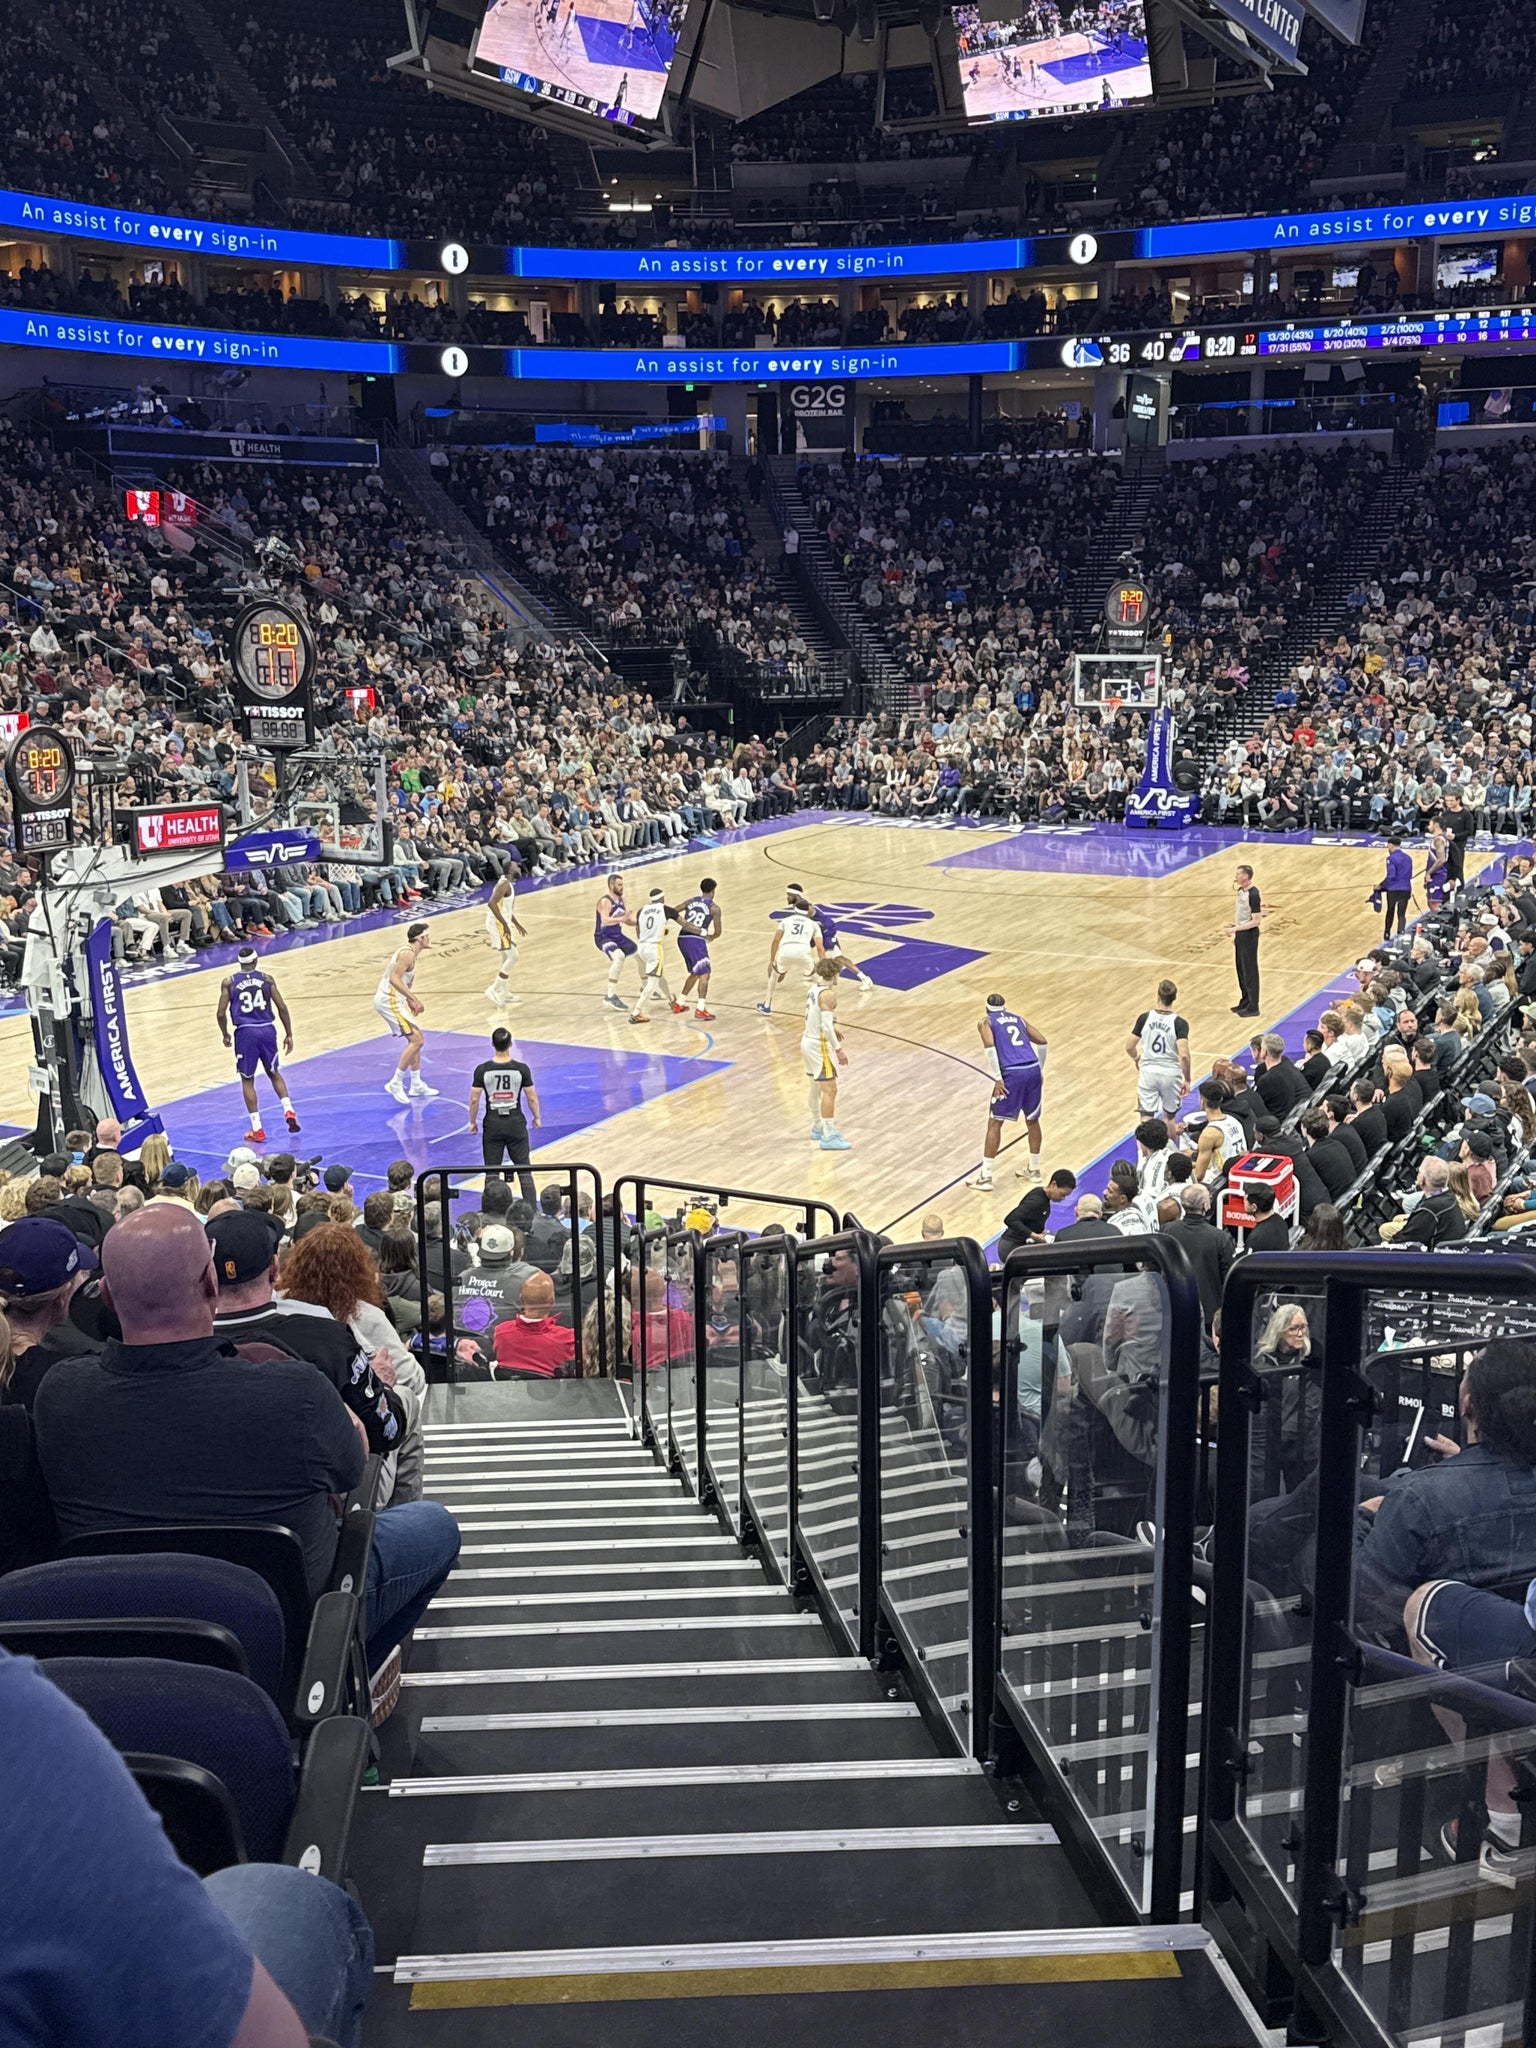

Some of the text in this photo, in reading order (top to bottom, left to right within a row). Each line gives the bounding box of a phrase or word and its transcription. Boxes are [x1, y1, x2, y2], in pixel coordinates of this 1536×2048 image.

[1257, 0, 1299, 47] CENTER
[504, 67, 521, 84] GSW
[541, 81, 551, 96] 36
[588, 97, 598, 111] 40
[617, 107, 629, 124] UTA
[22, 202, 277, 251] An assist for every sign-in
[1274, 203, 1536, 238] An assist for every sig
[638, 254, 903, 274] An assist for every sign-in
[1439, 322, 1445, 331] 5
[1460, 321, 1466, 329] 7
[1479, 320, 1488, 328] 12
[1501, 319, 1509, 327] 11
[1523, 317, 1529, 327] 2
[1323, 327, 1368, 338] 8/20 (40%)
[1381, 323, 1424, 335] 2/2 (100%)
[1499, 330, 1509, 339] 14
[1522, 329, 1529, 338] 4
[26, 320, 278, 358] An assist for every sign-in
[1245, 334, 1255, 344] 17
[1267, 330, 1313, 342] 13/30 (43%)
[1382, 335, 1421, 346] 3/4 (75%)
[1438, 334, 1444, 343] 6
[1457, 333, 1467, 341] 10
[1478, 332, 1488, 340] 16
[1206, 336, 1236, 357] 8:20
[1241, 345, 1256, 355] 2ND
[1268, 342, 1312, 353] 17/31 (55%)
[1324, 338, 1366, 350] 3/10 (30%)
[1109, 343, 1130, 363] 36
[1142, 341, 1165, 361] 40
[636, 355, 898, 374] An assist for every sign-in
[790, 384, 846, 408] G2G
[247, 443, 281, 454] HEALTH
[1121, 590, 1143, 602] 8:20
[1123, 603, 1140, 622] 17
[260, 624, 298, 645] 8:20
[268, 647, 297, 686] 17
[260, 707, 304, 718] TISSOT
[29, 749, 60, 768] 8:20
[1151, 723, 1161, 783] AMERICA FIRST
[35, 770, 56, 794] 17
[36, 808, 71, 820] TISSOT
[167, 816, 218, 835] HEALTH
[822, 817, 1096, 836] UTAH JAZZ
[168, 836, 197, 845] UNIVERSITY
[647, 916, 654, 929] 0
[687, 910, 705, 928] 28
[791, 924, 805, 936] 31
[239, 989, 267, 1013] 34
[100, 960, 137, 1100] AMERICA FIRST
[1007, 1026, 1023, 1046] 2
[1152, 1034, 1166, 1054] 61
[495, 1075, 511, 1090] 78
[469, 1276, 498, 1288] Protect
[459, 1285, 479, 1295] Home
[1447, 1293, 1488, 1306] Travelpass
